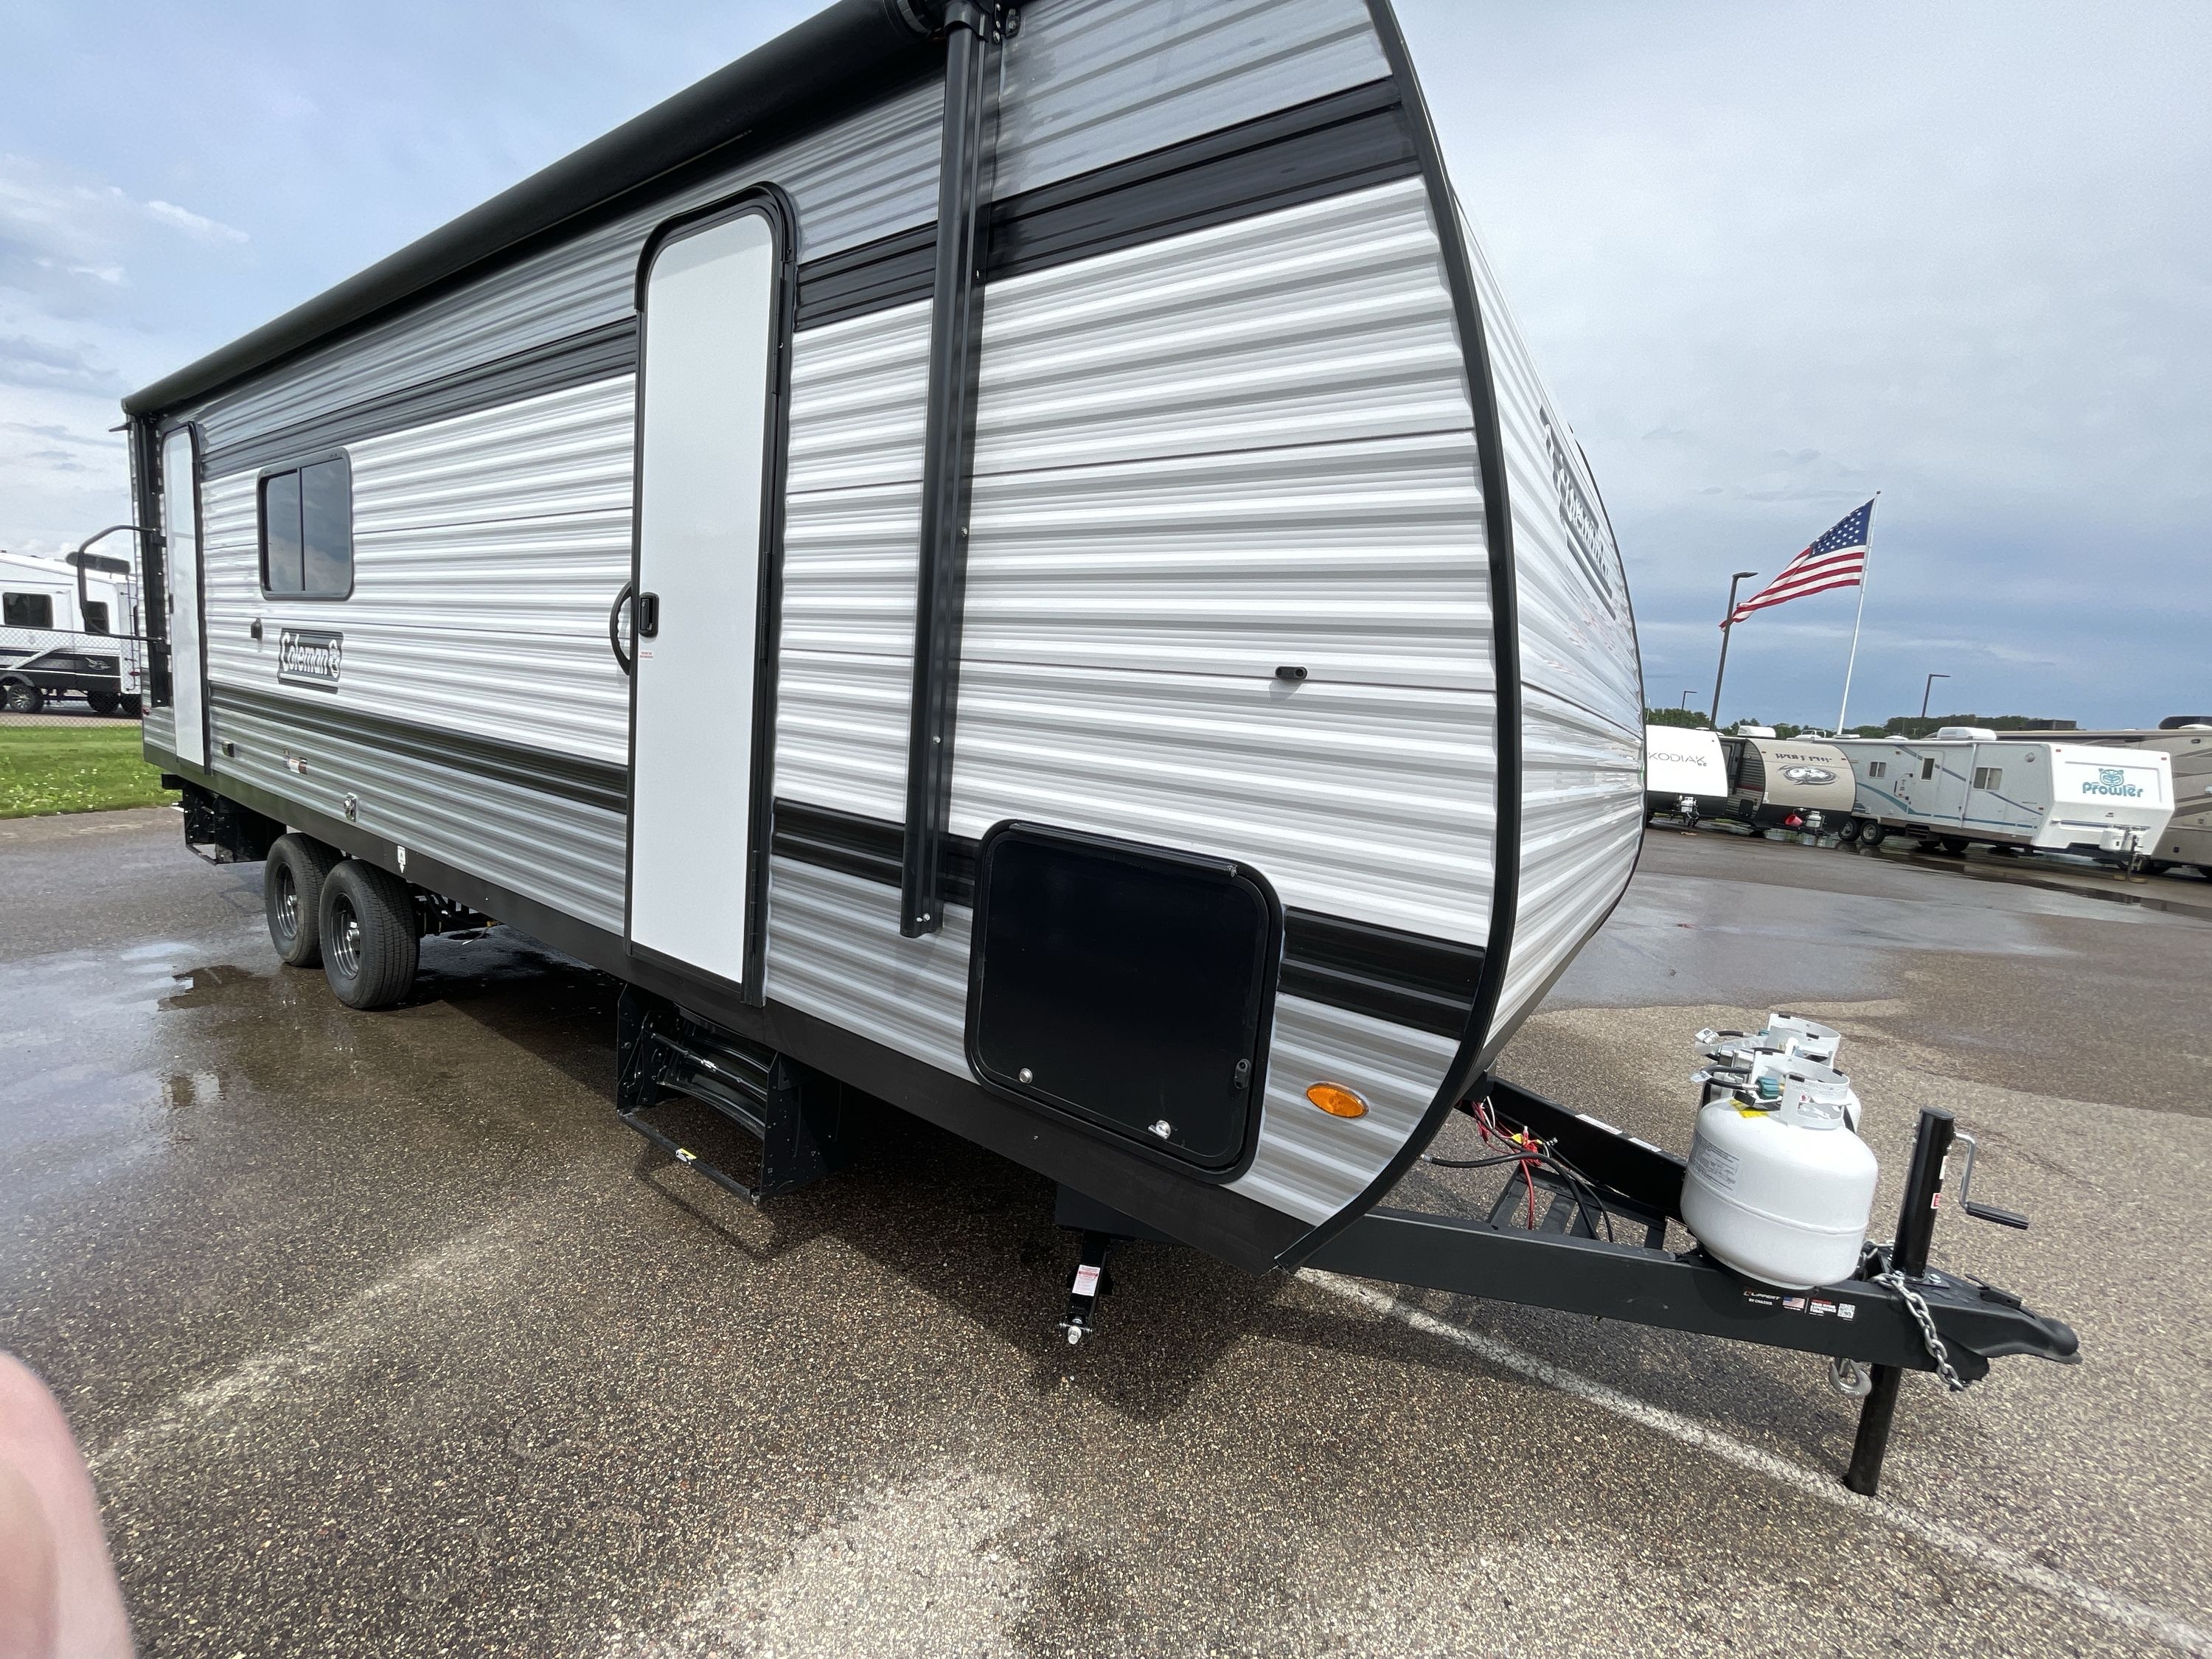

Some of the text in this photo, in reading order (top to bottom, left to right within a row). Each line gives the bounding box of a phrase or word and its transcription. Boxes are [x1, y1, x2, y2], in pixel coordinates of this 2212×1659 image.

[281, 632, 328, 675] Coleman
[1648, 752, 1705, 763] KODIAK
[2082, 782, 2143, 797] Prowler
